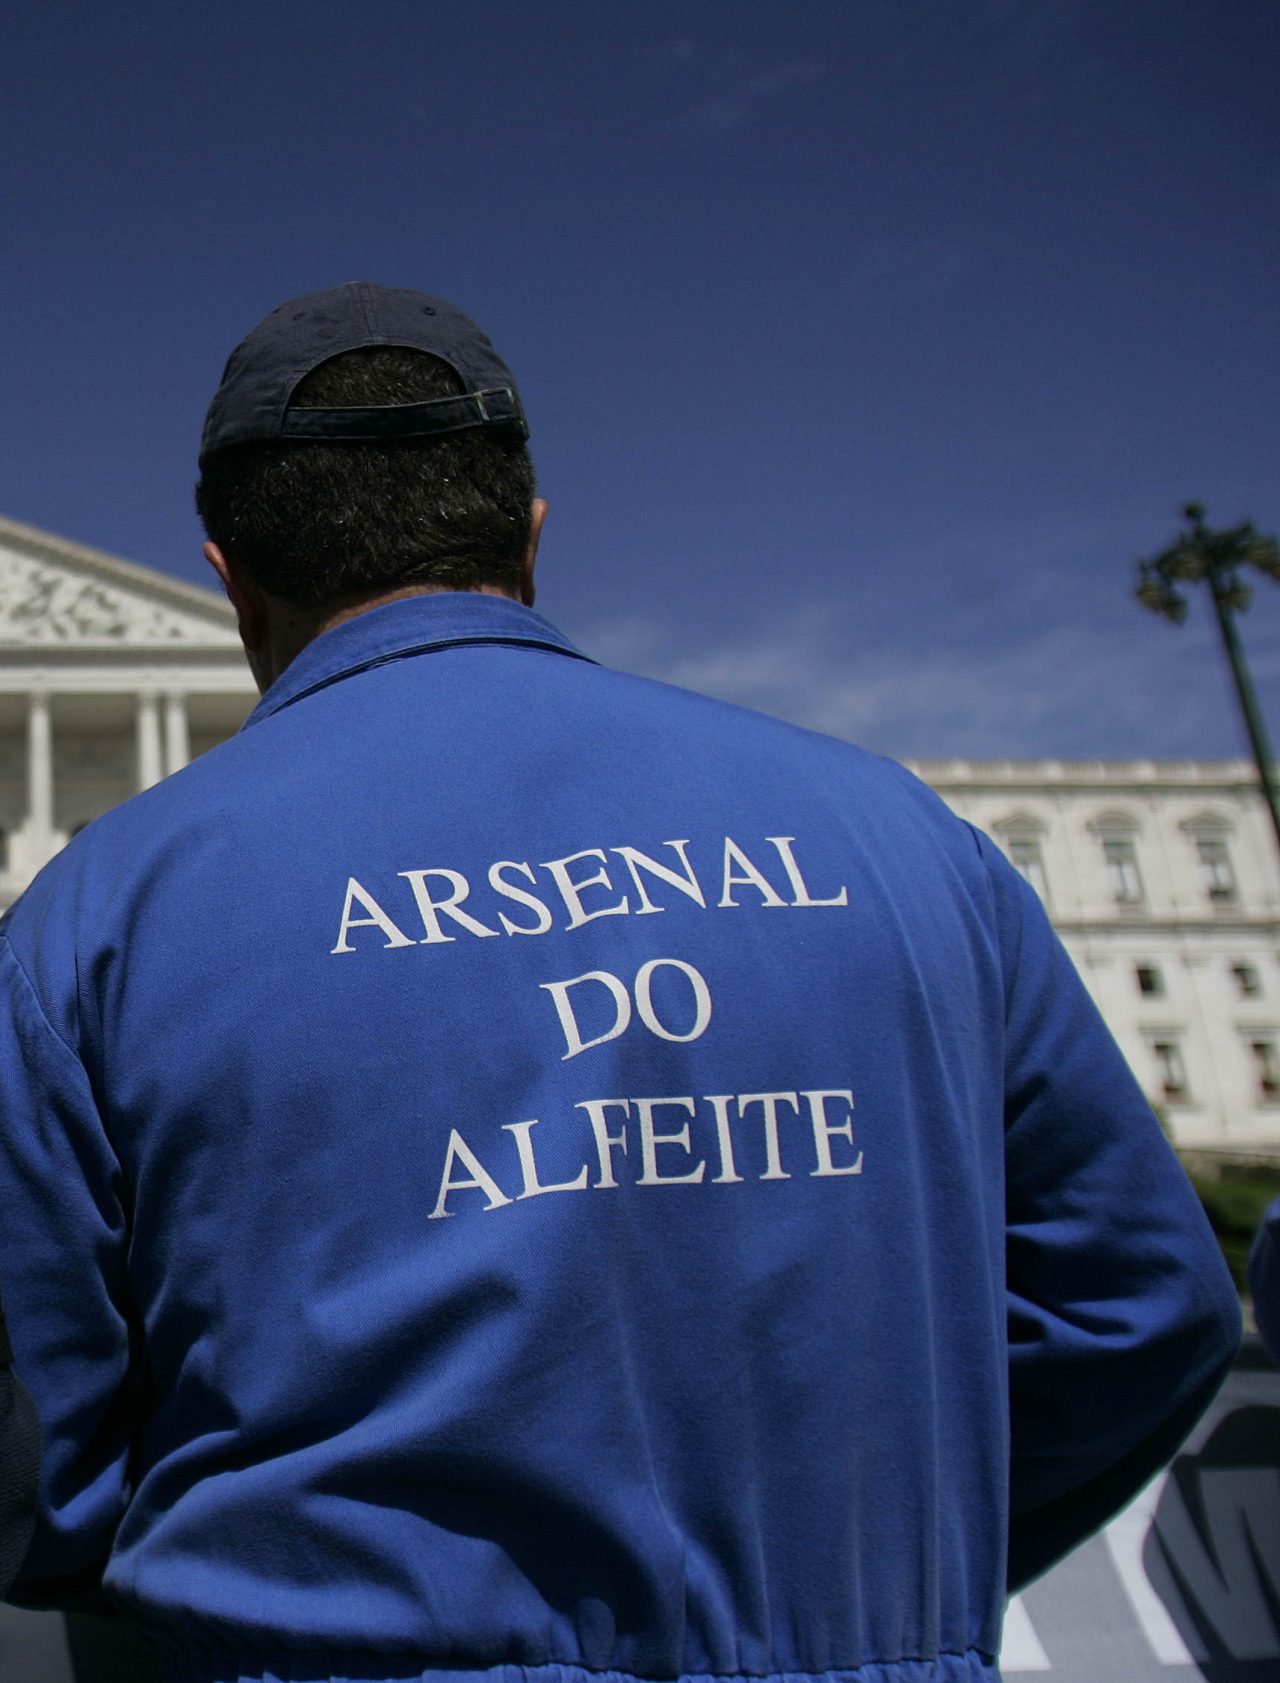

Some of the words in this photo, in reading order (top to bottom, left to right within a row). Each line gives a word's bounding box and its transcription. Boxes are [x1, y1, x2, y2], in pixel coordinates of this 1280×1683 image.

[330, 836, 849, 955] ARSENAL
[539, 958, 713, 1061] DO
[427, 1089, 864, 1219] ALFEITE
